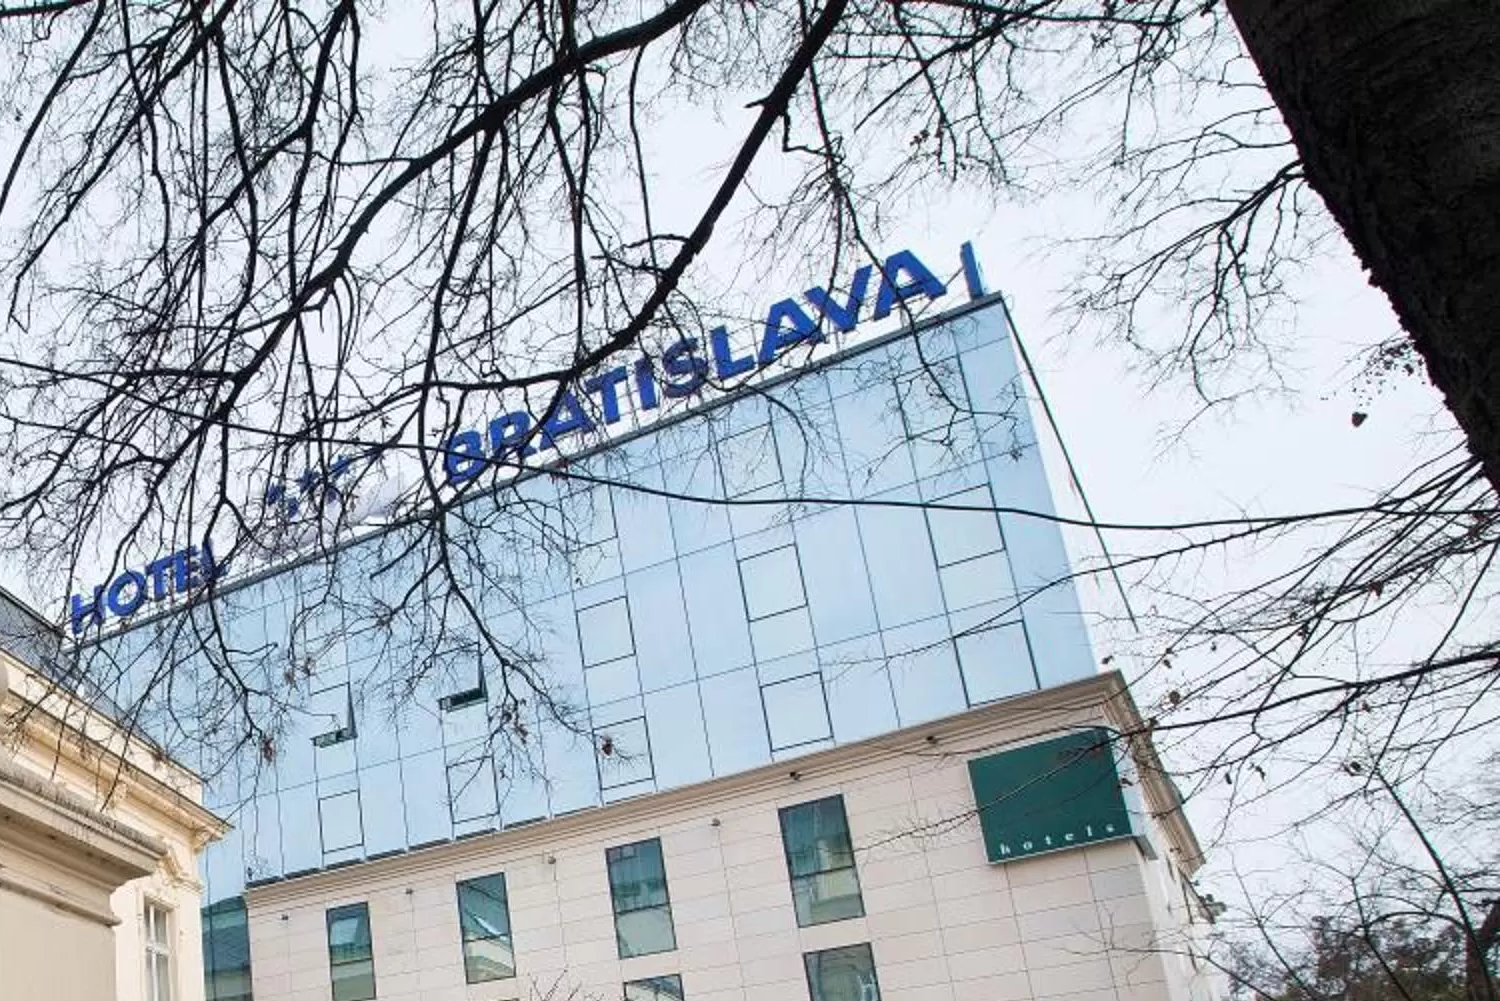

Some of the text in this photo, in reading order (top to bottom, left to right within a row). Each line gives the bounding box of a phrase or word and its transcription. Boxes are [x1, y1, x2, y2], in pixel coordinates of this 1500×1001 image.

[71, 249, 947, 635] HOTEL BRATISLAVA
[1000, 823, 1115, 855] hotels
